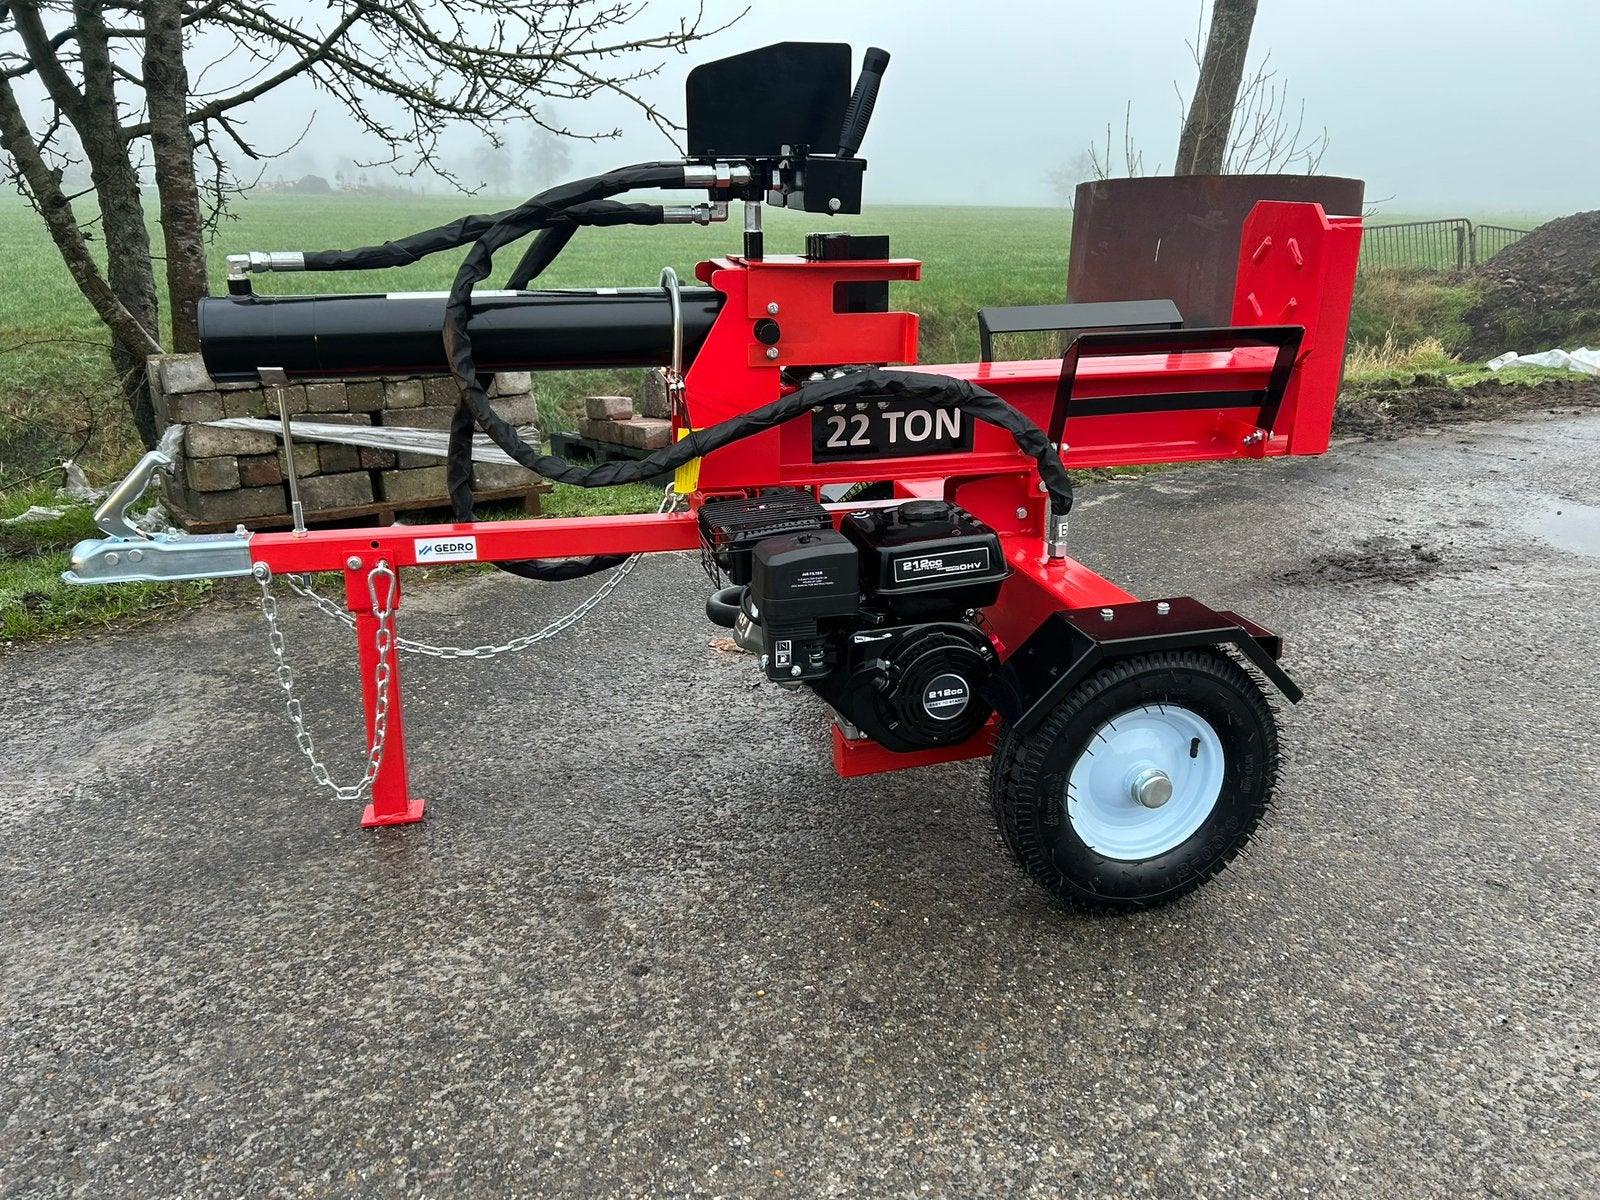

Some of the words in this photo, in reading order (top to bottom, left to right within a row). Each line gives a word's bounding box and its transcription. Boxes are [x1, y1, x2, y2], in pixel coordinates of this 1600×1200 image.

[826, 413, 871, 448] 22
[881, 407, 961, 443] TON
[434, 542, 474, 552] GEDRO
[959, 562, 981, 571] OHV
